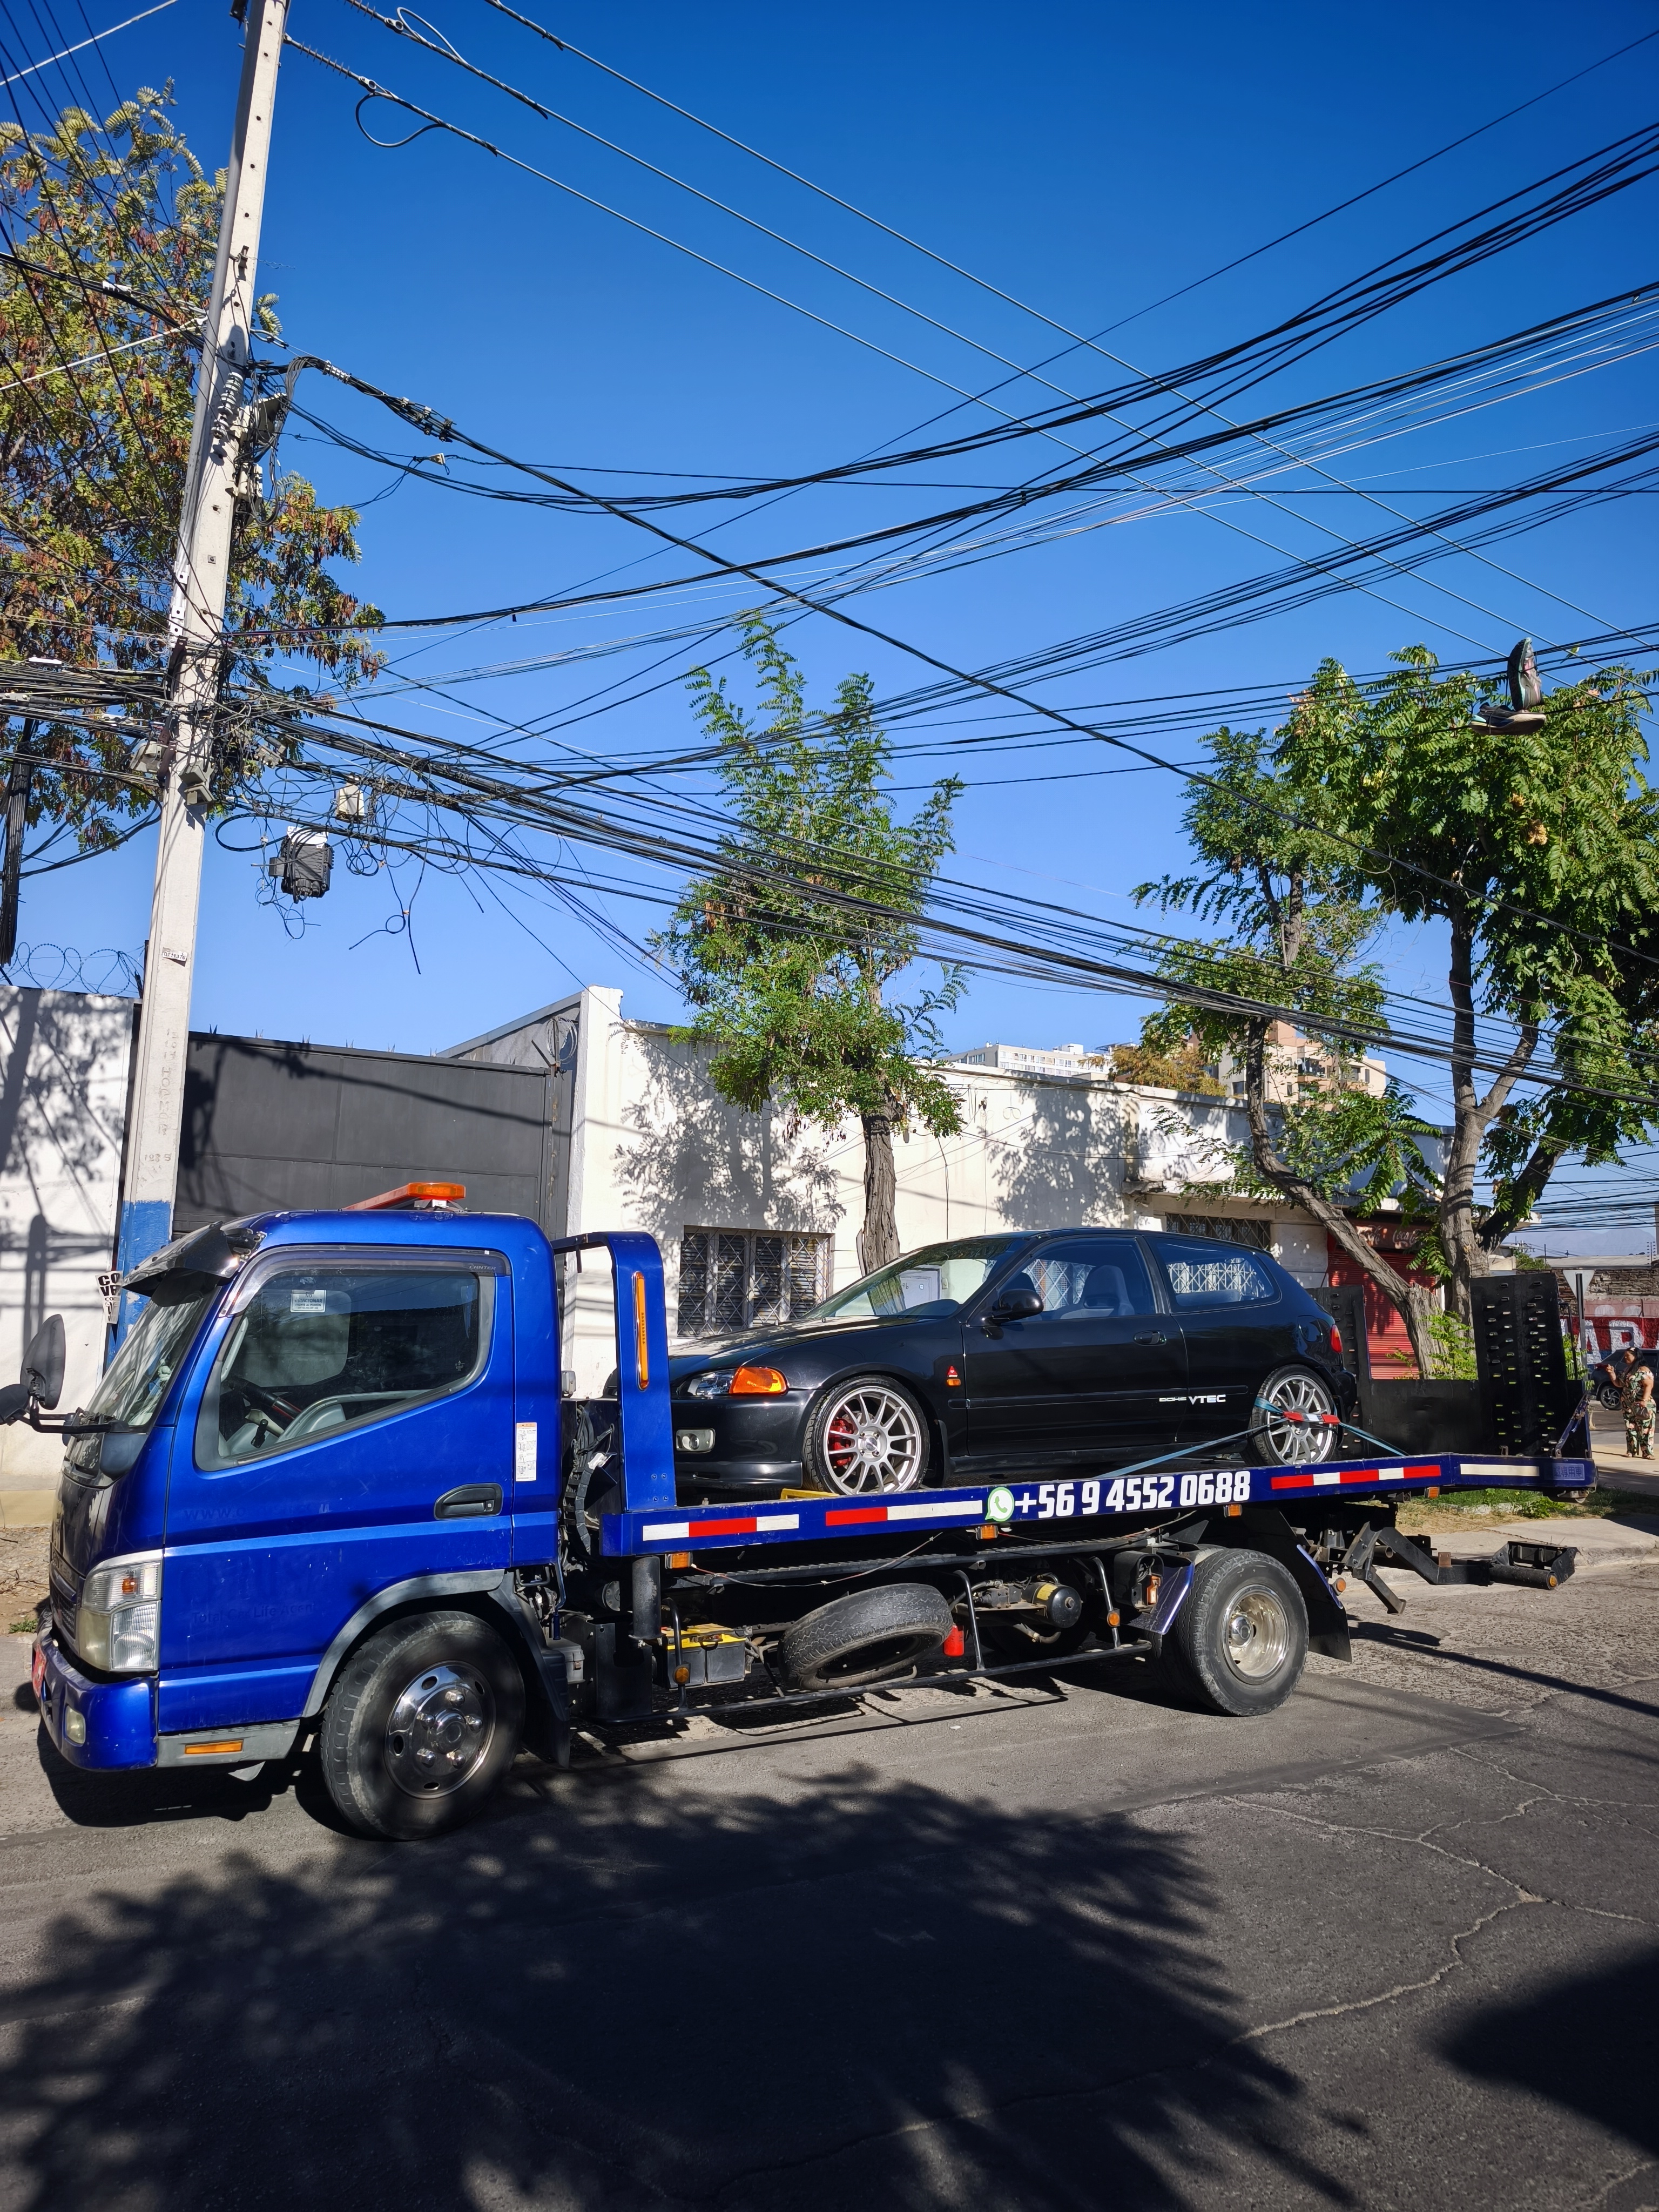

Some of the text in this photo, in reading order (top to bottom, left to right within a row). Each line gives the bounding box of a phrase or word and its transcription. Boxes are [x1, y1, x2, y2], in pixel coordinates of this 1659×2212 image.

[1188, 1394, 1226, 1405] VTEC
[1015, 1471, 1251, 1518] +56 9 4552 0688
[253, 1604, 277, 1618] Life
